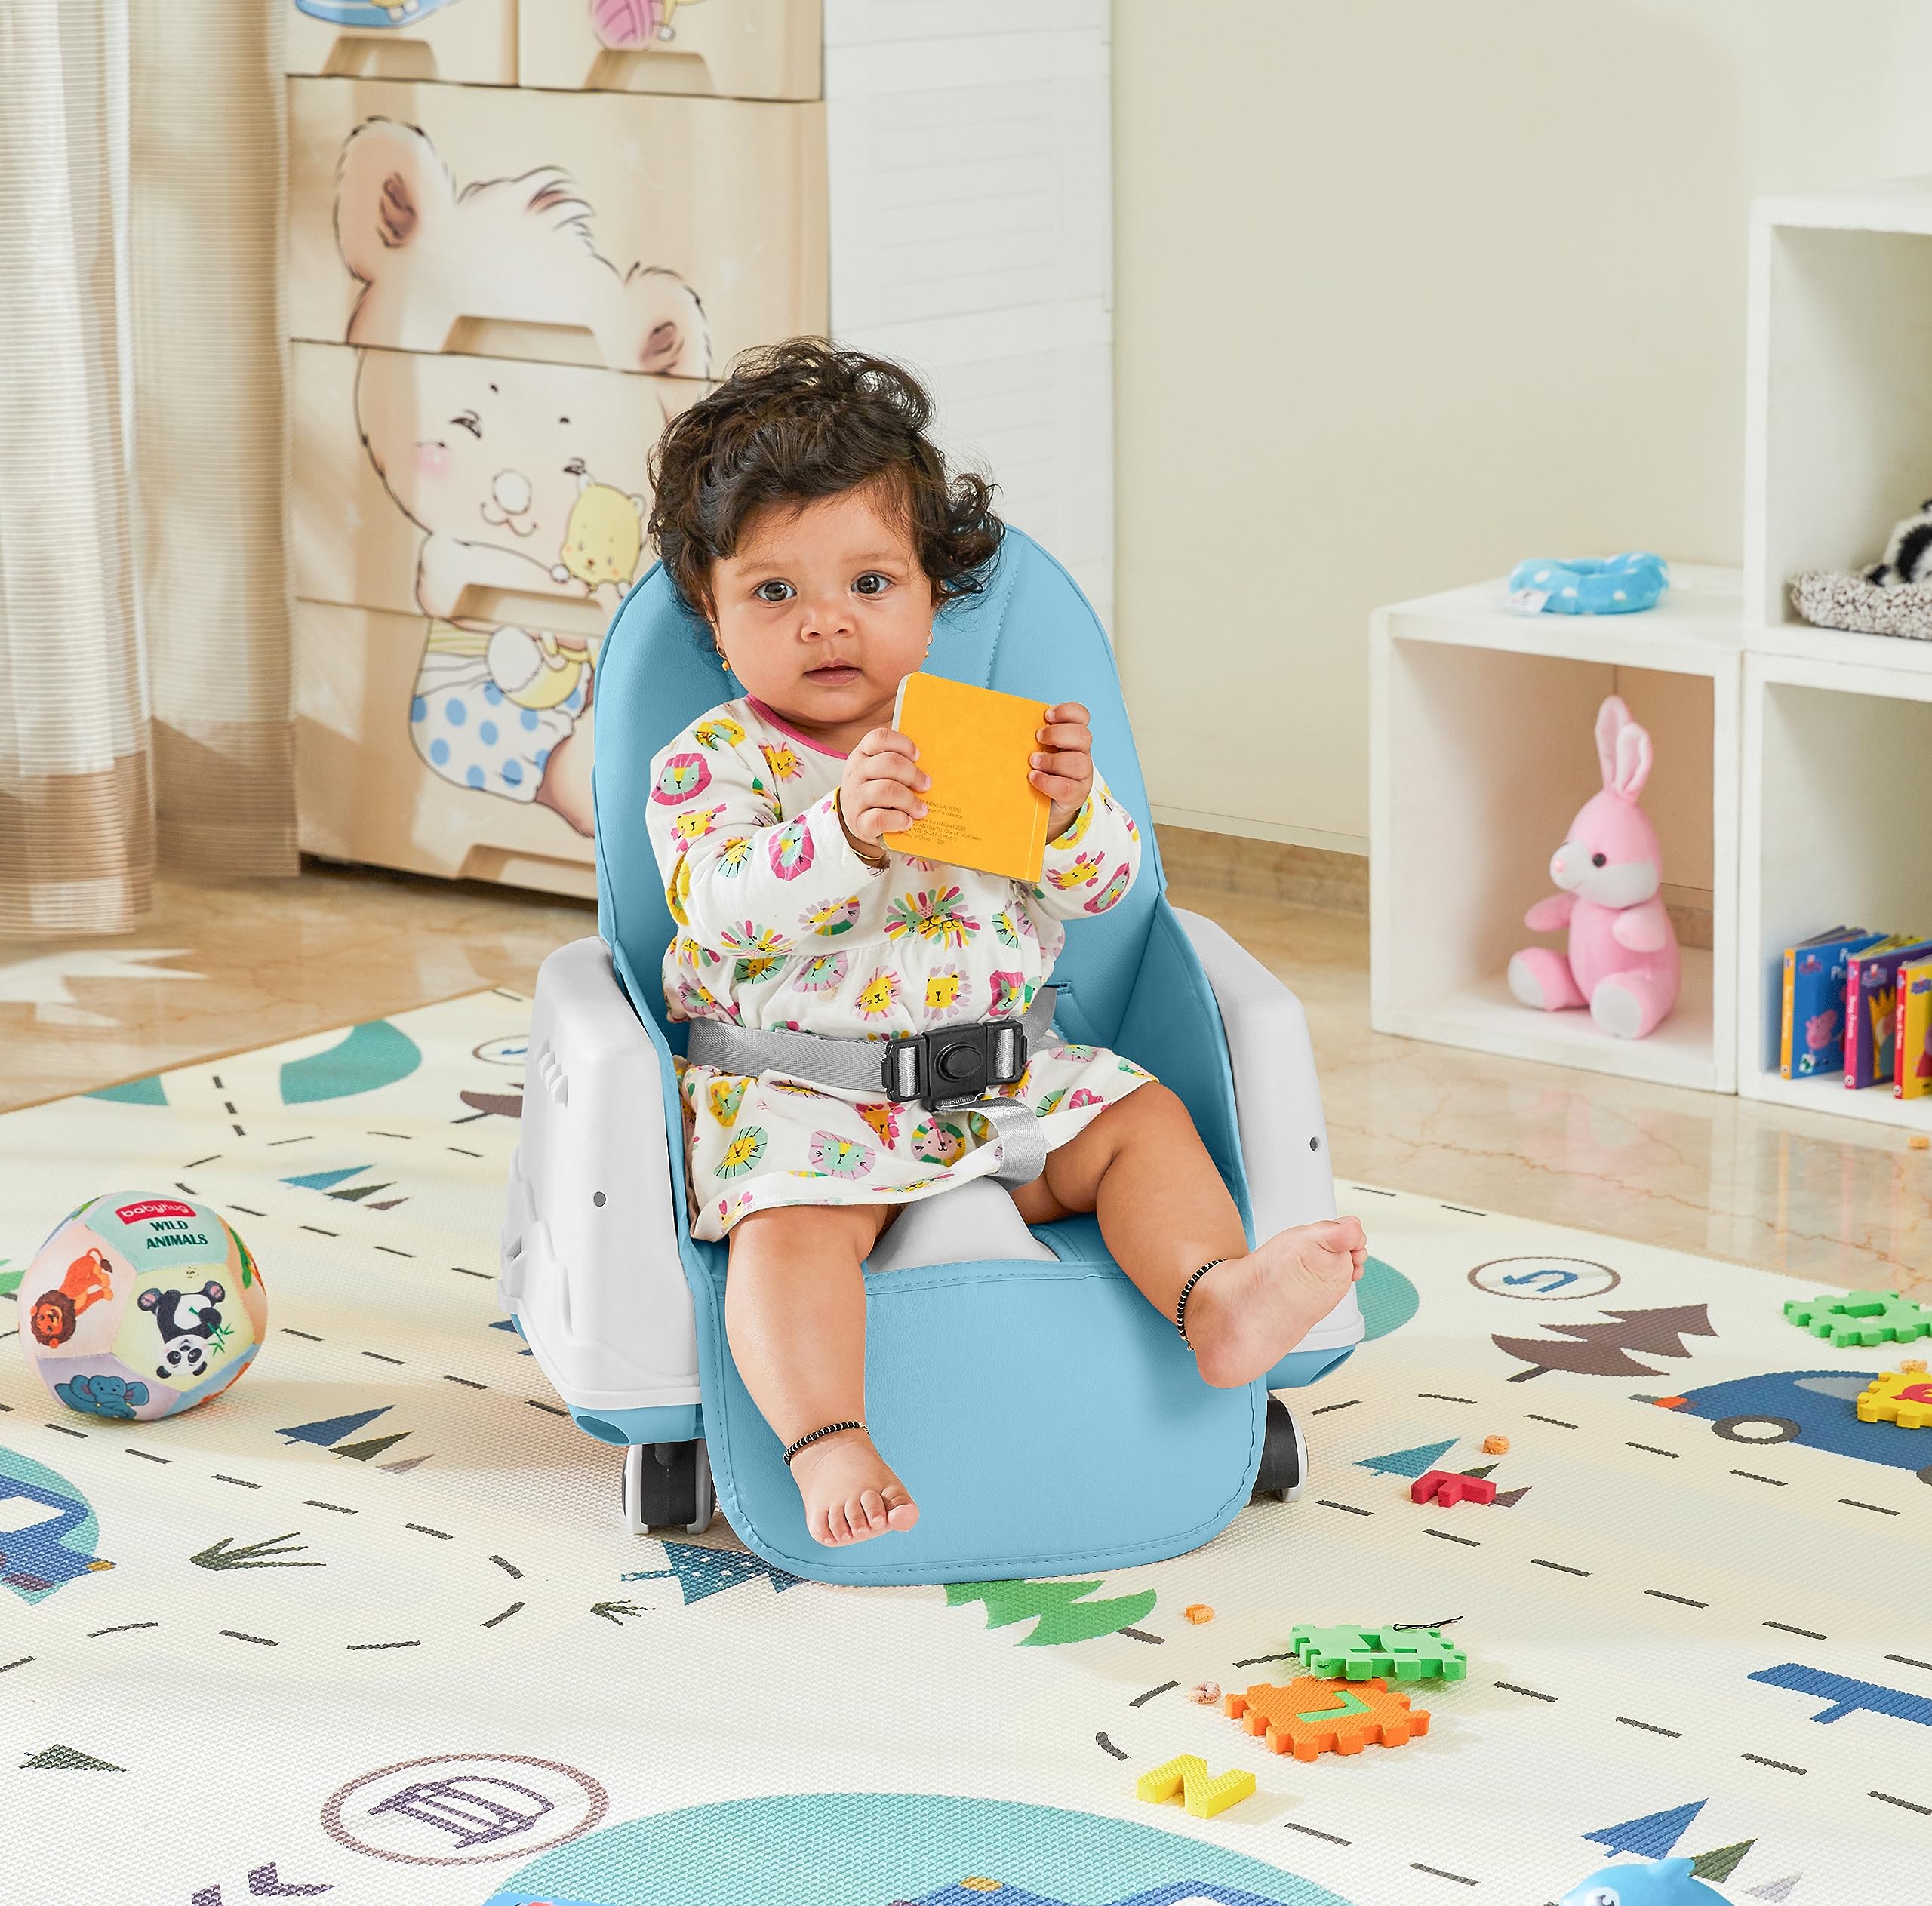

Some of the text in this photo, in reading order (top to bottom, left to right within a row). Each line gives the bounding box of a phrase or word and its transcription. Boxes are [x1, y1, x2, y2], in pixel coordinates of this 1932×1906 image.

[121, 1203, 189, 1217] babyhug
[150, 1220, 188, 1231] WILD
[146, 1234, 208, 1249] ANIMALS
